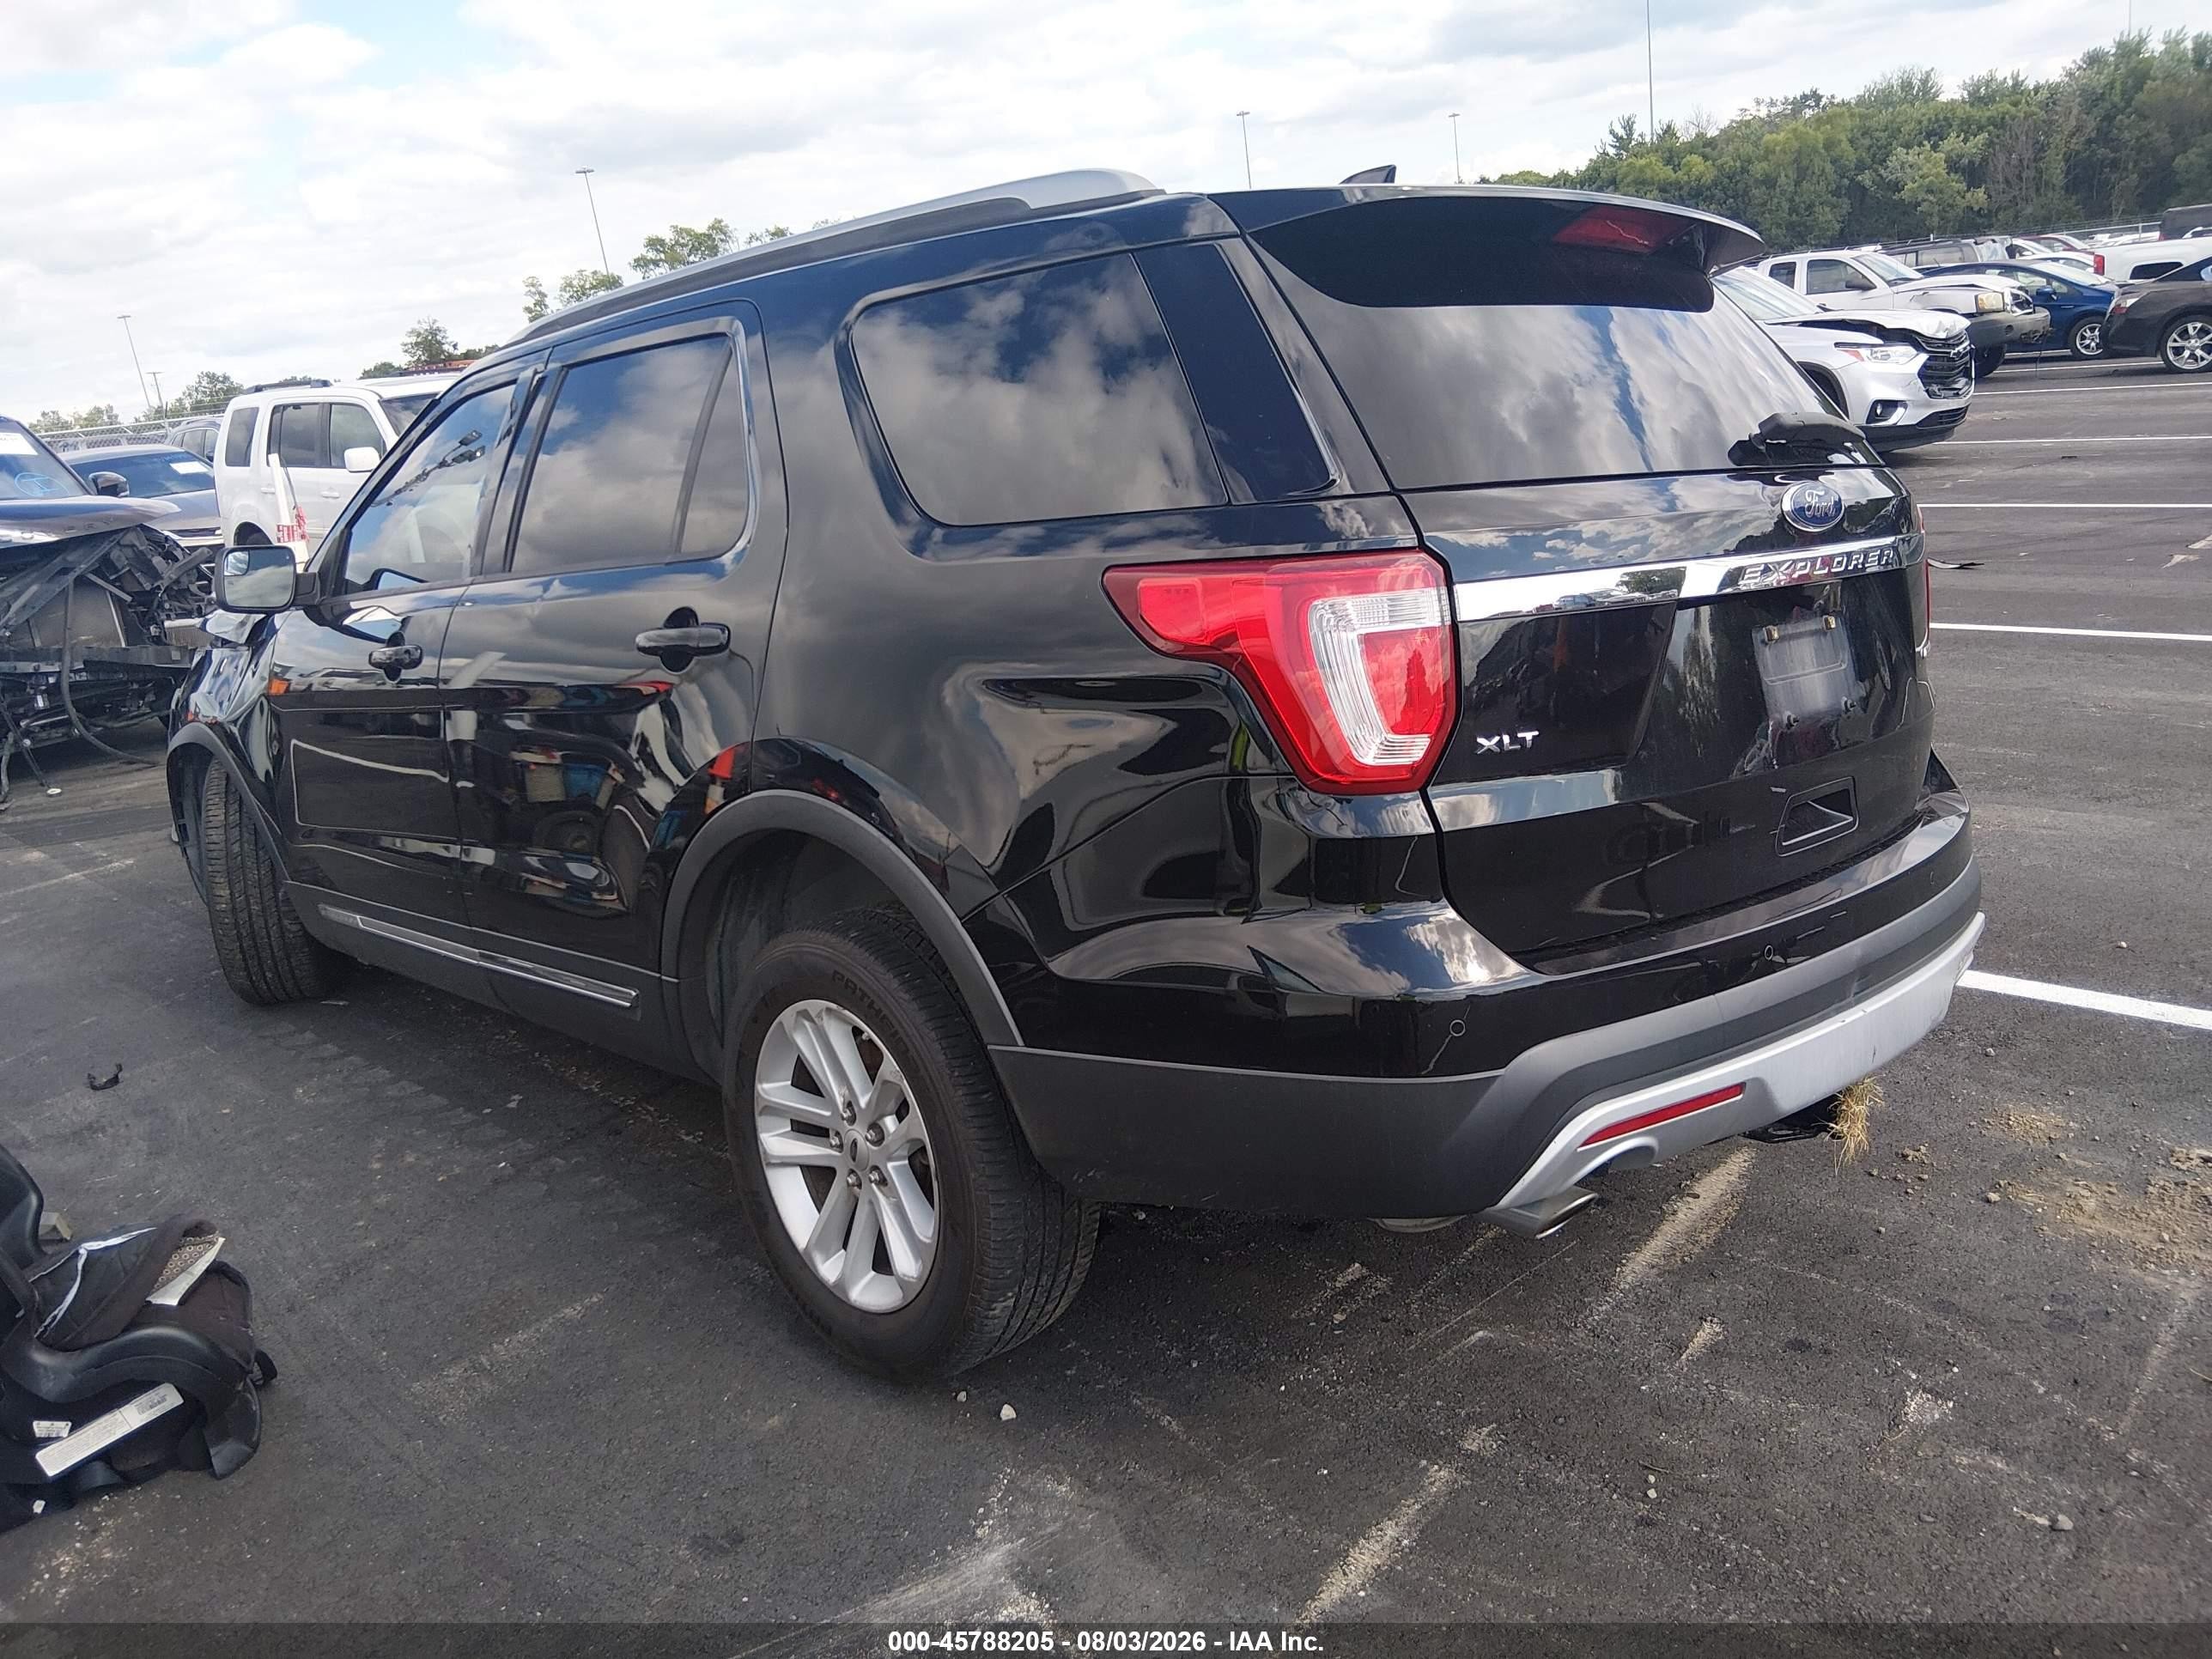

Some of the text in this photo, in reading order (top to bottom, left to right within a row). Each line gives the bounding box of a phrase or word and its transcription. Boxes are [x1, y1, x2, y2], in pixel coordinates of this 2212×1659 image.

[1804, 489, 1837, 518] Ford
[1741, 547, 1894, 584] EXPLORER
[1475, 730, 1540, 755] XLT
